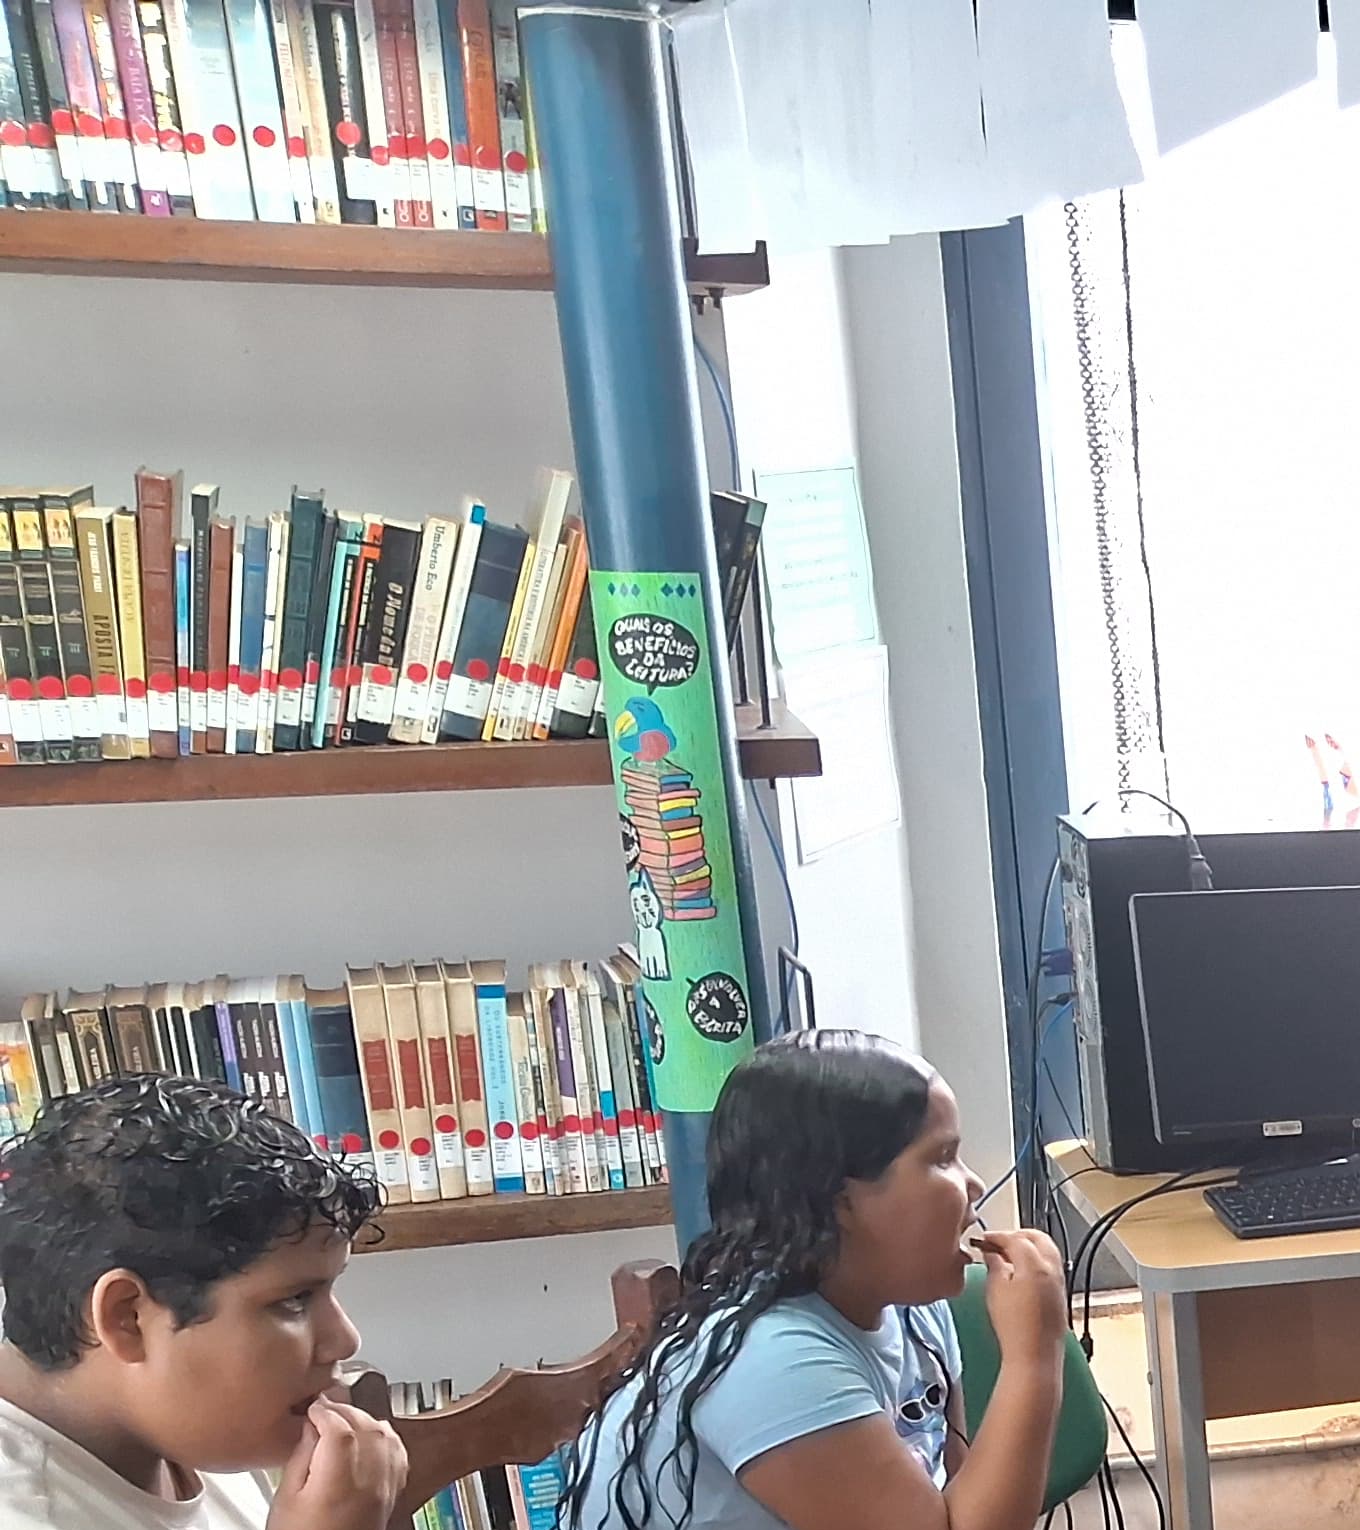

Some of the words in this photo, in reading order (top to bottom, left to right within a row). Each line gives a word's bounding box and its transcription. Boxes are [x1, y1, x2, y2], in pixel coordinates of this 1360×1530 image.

[426, 525, 446, 570] Umberto
[425, 573, 439, 591] Eco
[614, 618, 650, 636] QUAIS
[652, 620, 674, 637] OS
[615, 634, 697, 659] BENEFÍCIOS
[625, 658, 694, 683] LEITURA?
[643, 652, 666, 668] DA
[708, 996, 720, 1008] A
[694, 1010, 743, 1035] ESCRITA
